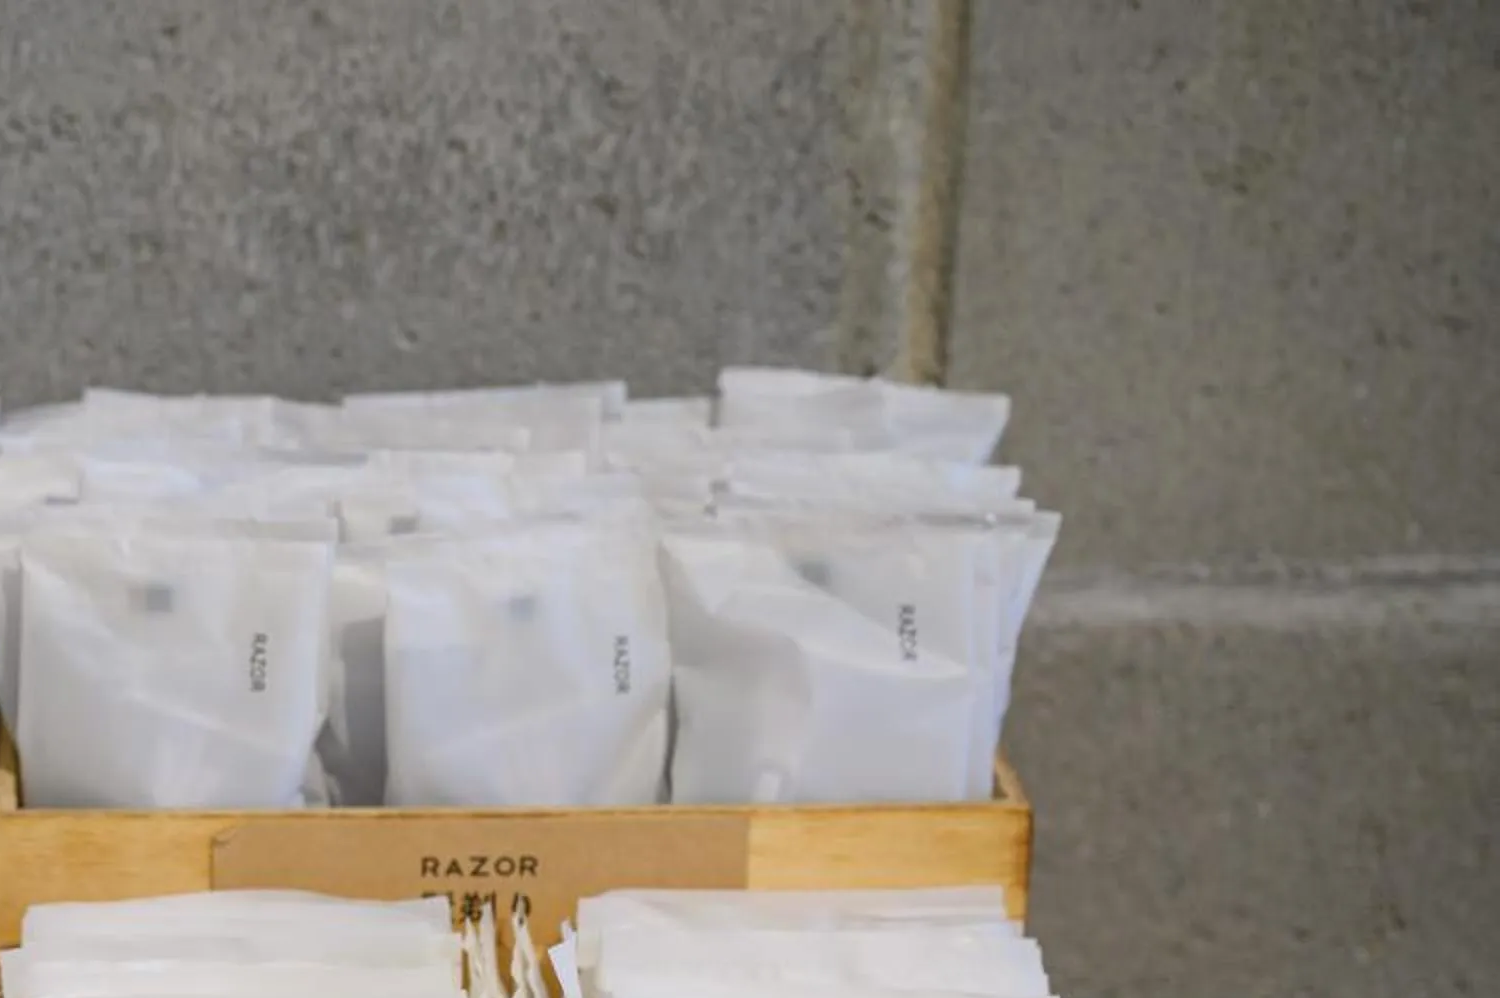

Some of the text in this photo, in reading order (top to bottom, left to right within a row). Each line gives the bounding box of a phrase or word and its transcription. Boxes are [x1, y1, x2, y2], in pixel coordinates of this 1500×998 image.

[898, 604, 917, 660] RAZOR
[250, 633, 267, 691] RAZOR
[614, 635, 630, 695] RAZOR
[420, 855, 539, 878] RAZOR
